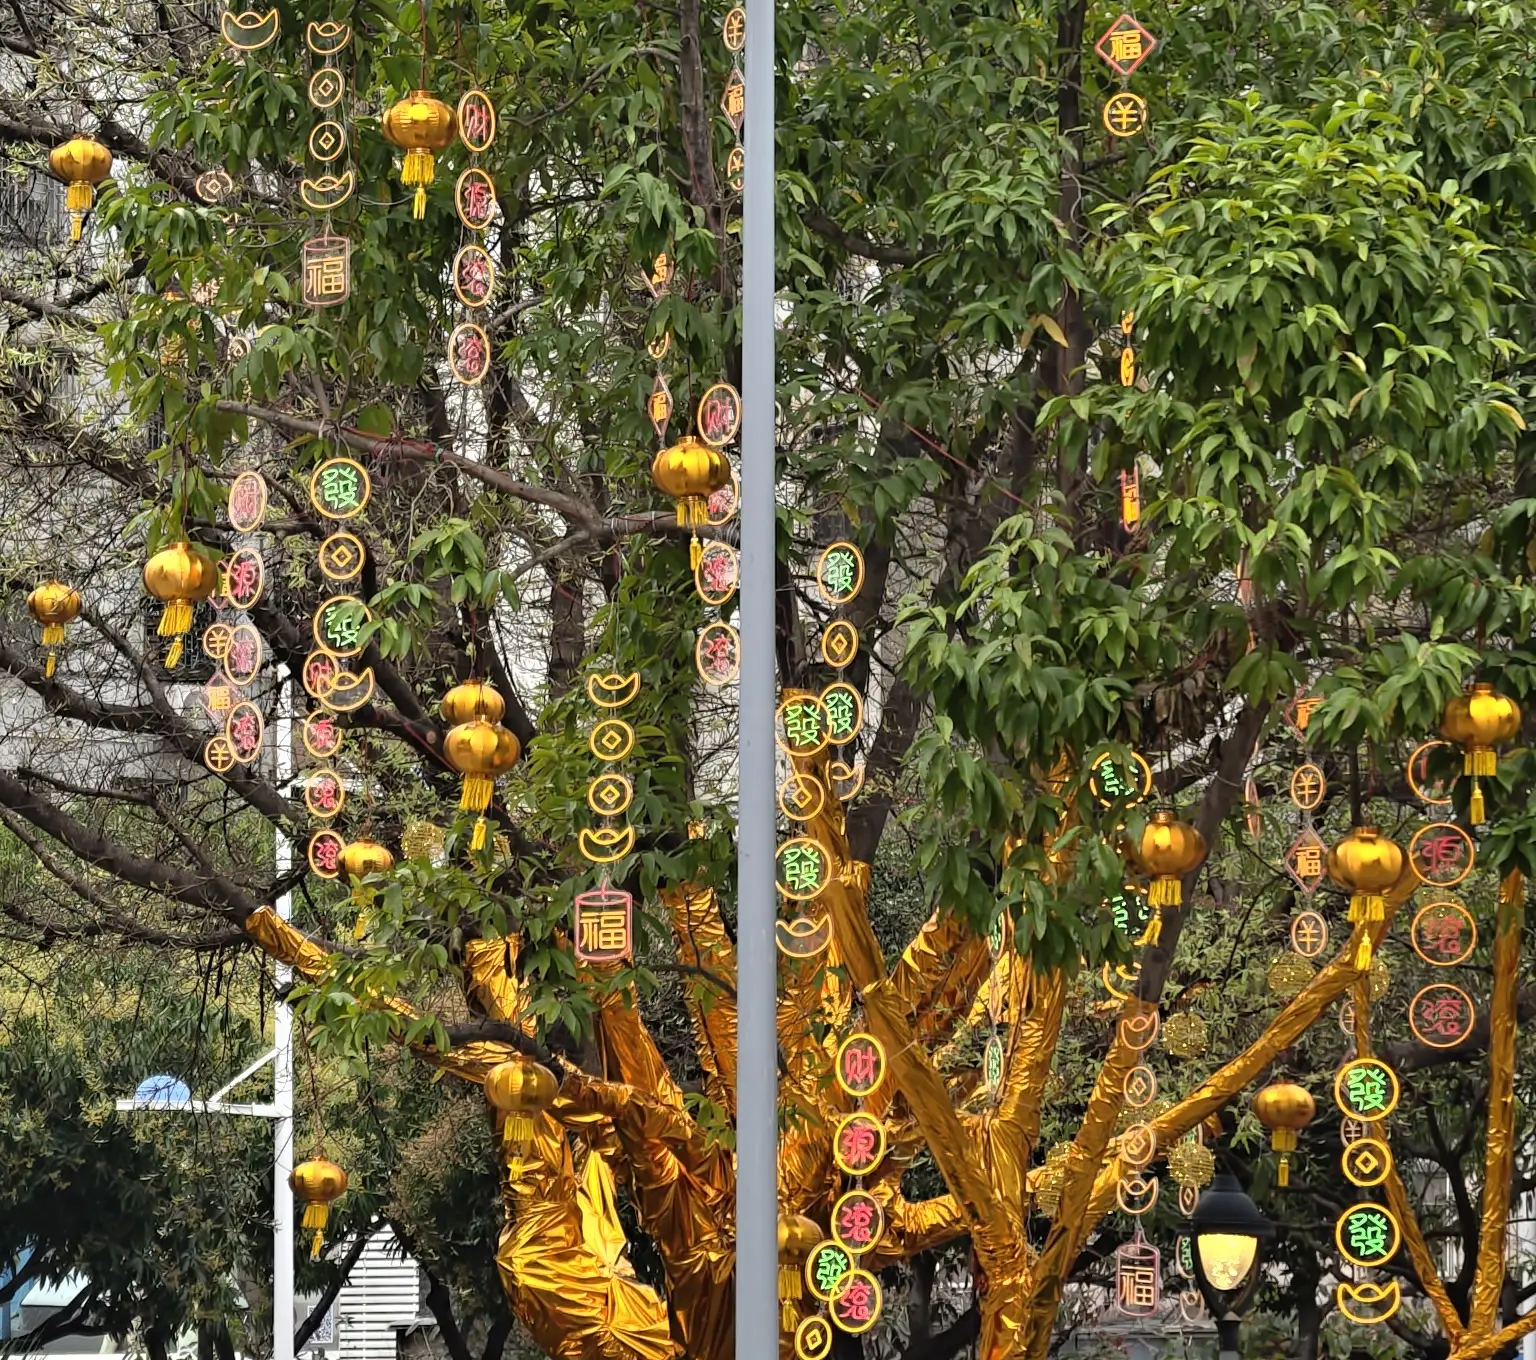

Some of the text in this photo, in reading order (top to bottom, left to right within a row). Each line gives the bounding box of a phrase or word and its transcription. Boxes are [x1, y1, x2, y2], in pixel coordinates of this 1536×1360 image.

[1111, 30, 1142, 62] 福
[307, 256, 345, 296] 福
[322, 467, 360, 508] 發
[827, 551, 853, 593] 發
[785, 702, 821, 747] 發
[825, 691, 852, 734] 發
[783, 846, 820, 890] 發
[1296, 847, 1321, 878] 福
[580, 910, 626, 951] 福
[844, 1045, 877, 1084] 财
[1347, 1068, 1387, 1112] 發
[842, 1126, 876, 1165] 源
[1347, 1212, 1388, 1257] 發
[1120, 1266, 1156, 1307] 福
